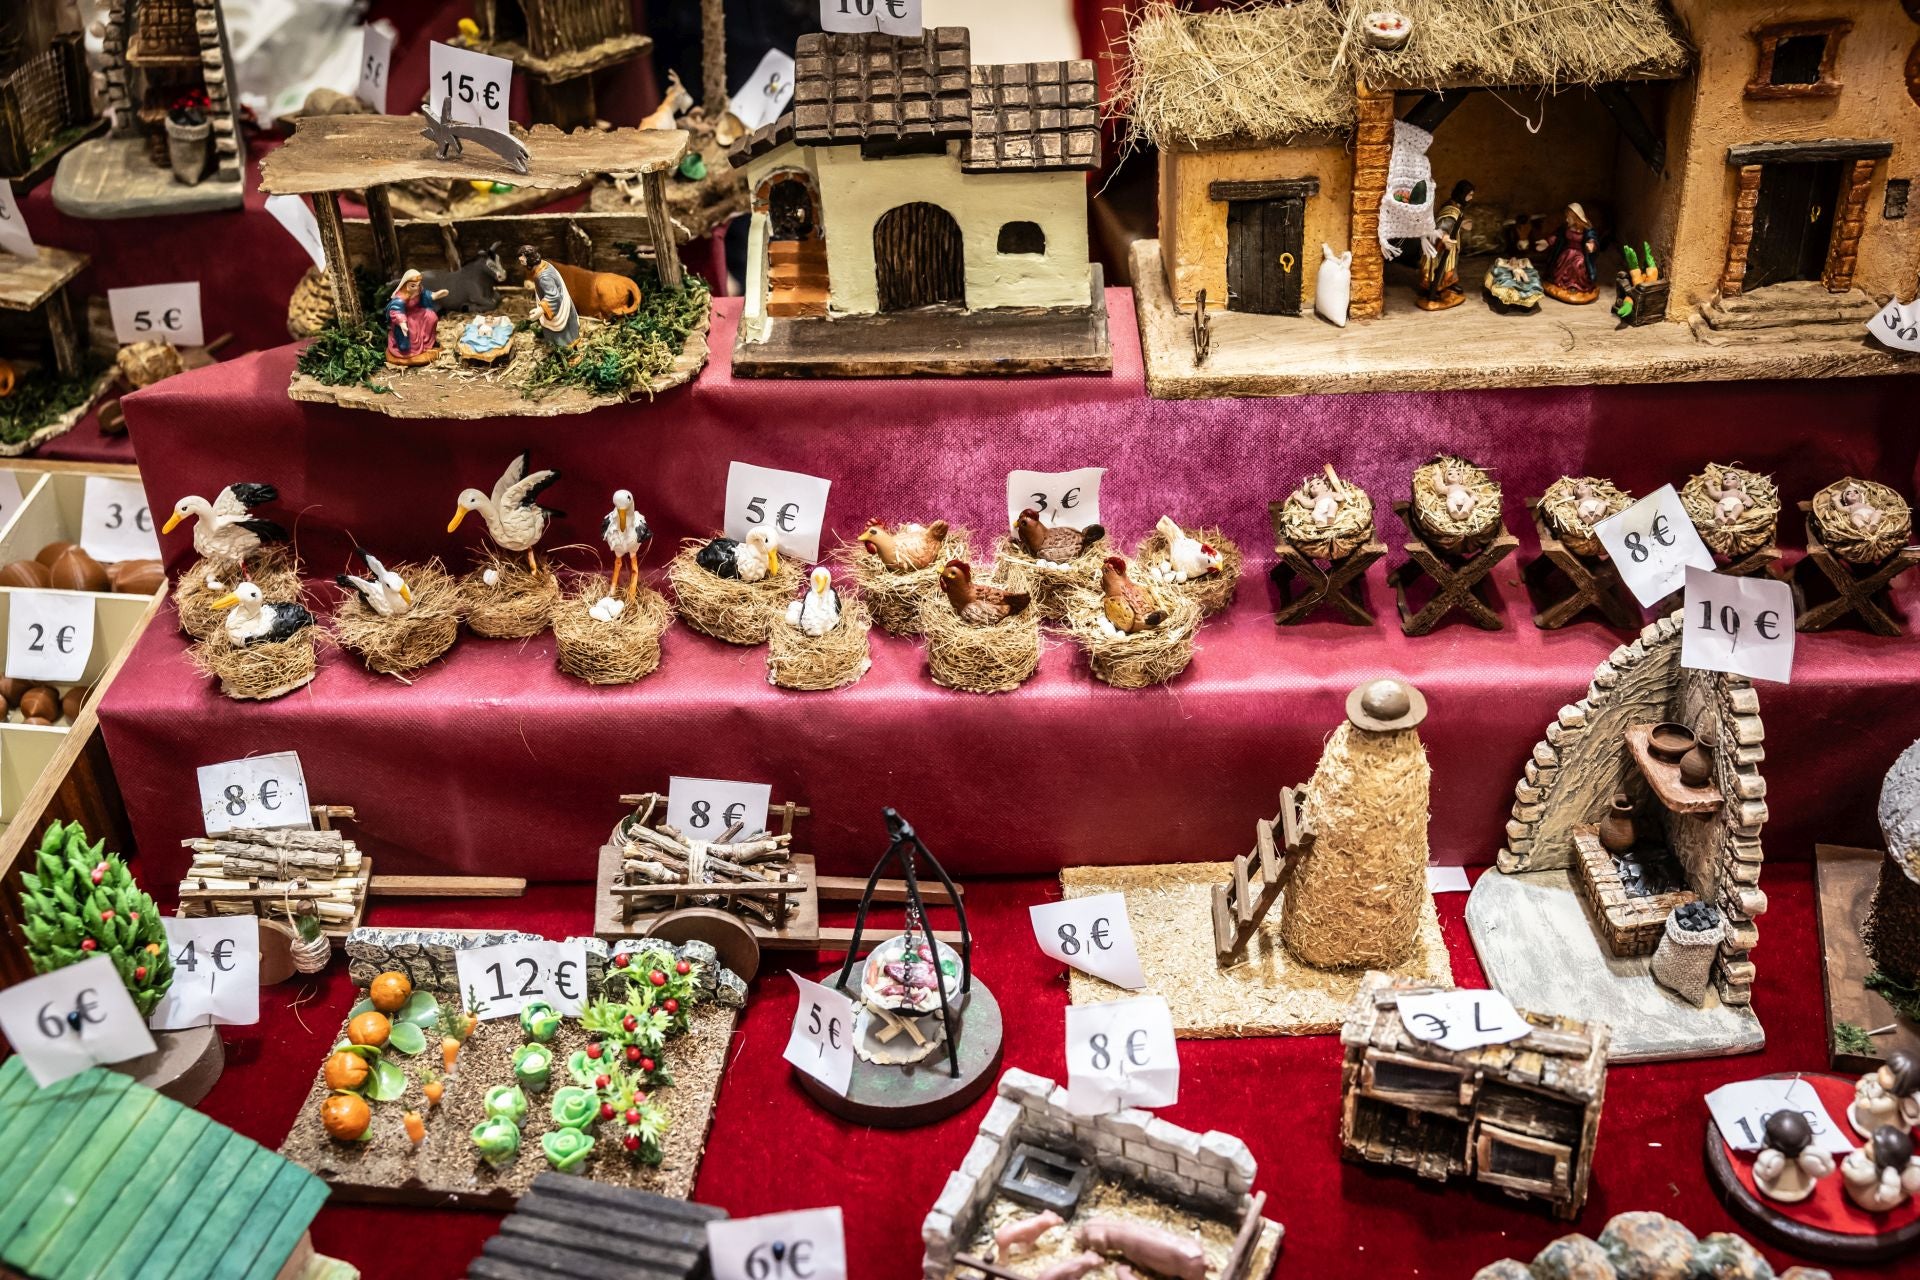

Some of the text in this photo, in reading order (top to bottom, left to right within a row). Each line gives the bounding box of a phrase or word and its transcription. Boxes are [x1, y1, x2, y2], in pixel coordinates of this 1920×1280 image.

[836, 0, 908, 19] 10 €
[365, 56, 374, 81] 5
[441, 70, 501, 110] 15 €
[133, 308, 183, 331] 5 €
[104, 502, 154, 533] 3 €
[745, 496, 800, 532] 5 €
[1029, 487, 1081, 513] 3 €
[1623, 514, 1676, 564] 8 €
[28, 623, 76, 654] 2 €
[1697, 600, 1781, 640] 10 €
[223, 779, 283, 817] 8 €
[689, 800, 747, 830] 8 €
[1057, 916, 1115, 956] 8 €
[175, 937, 236, 973] 4 €
[484, 956, 580, 1003] 12 €
[36, 987, 108, 1040] 6 €
[808, 1002, 843, 1051] 5 €
[1473, 1001, 1502, 1032] 7
[1088, 1028, 1151, 1071] 8 €
[745, 1239, 817, 1280] 6 €
